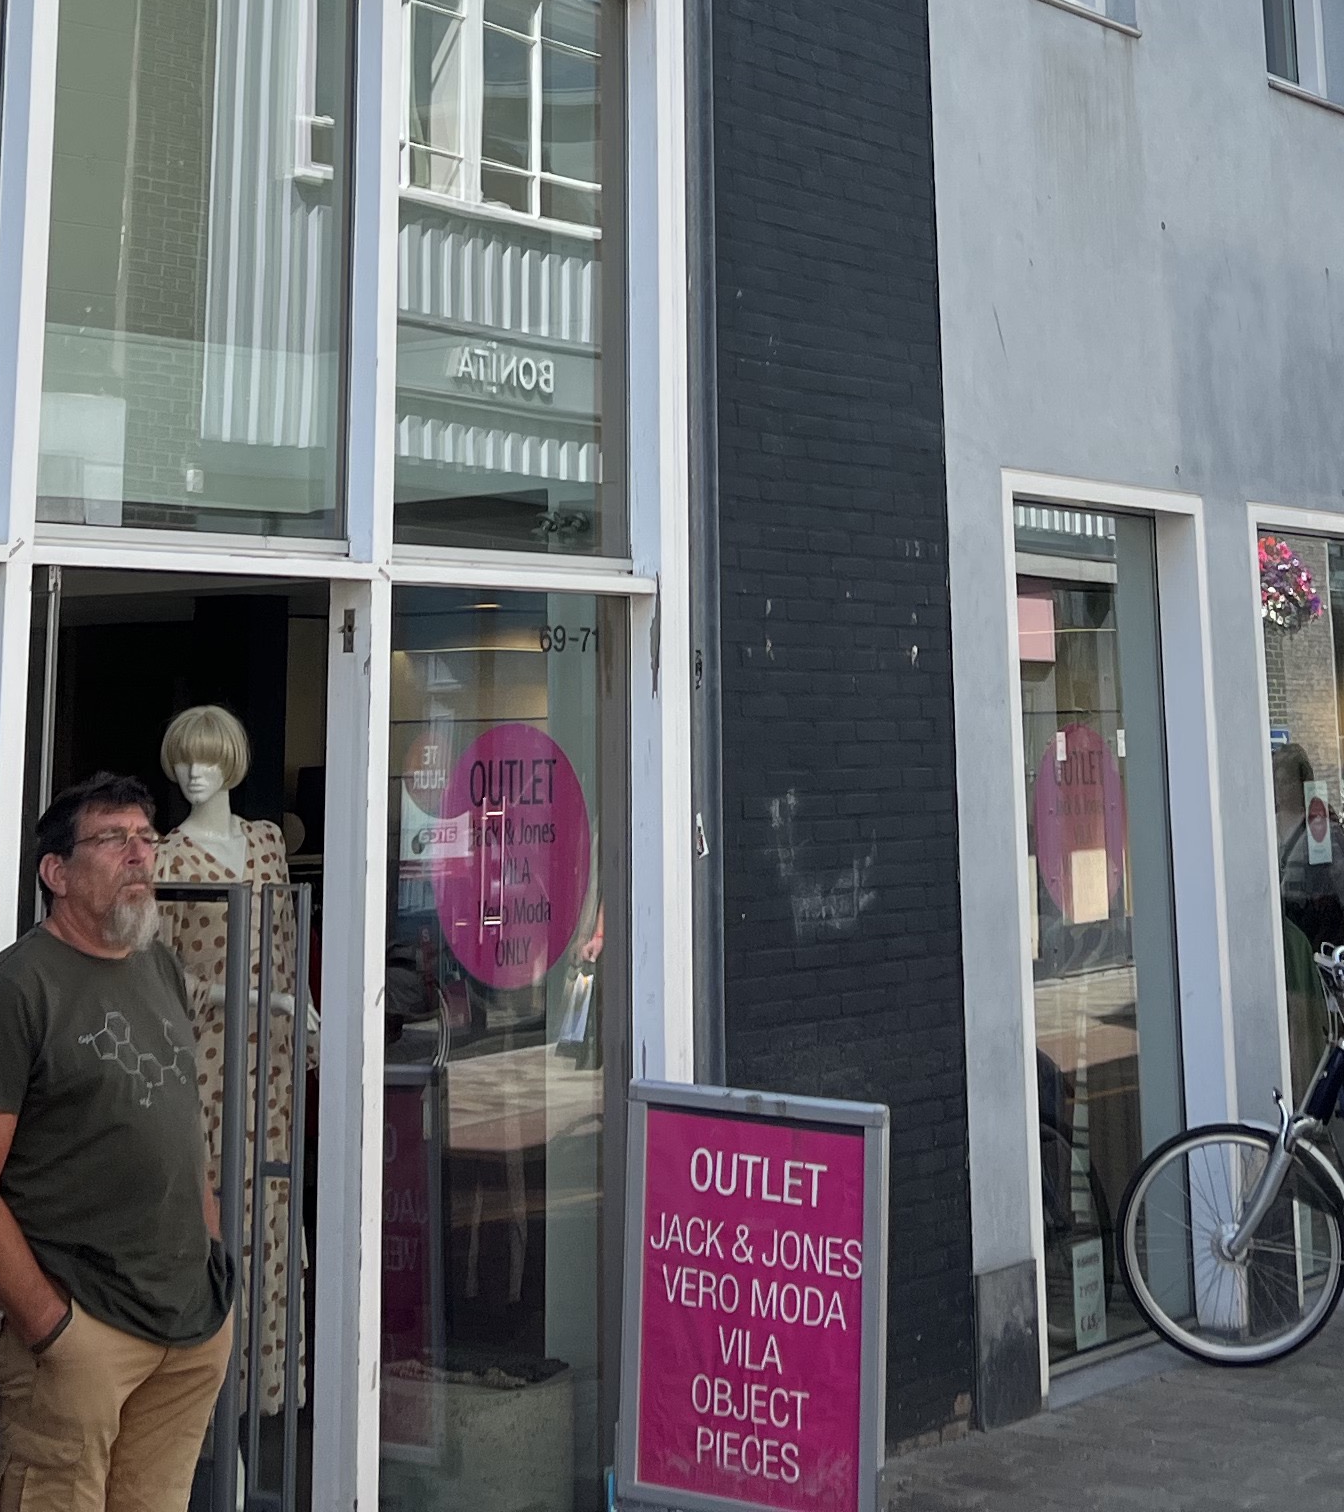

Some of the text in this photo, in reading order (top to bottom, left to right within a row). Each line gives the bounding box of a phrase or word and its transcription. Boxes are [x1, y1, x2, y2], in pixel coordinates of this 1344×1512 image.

[539, 625, 599, 653] 69-71
[469, 758, 557, 807] OUTLET
[519, 819, 556, 846] Jones
[513, 897, 551, 925] Moda
[495, 940, 531, 968] ONLY
[690, 1147, 828, 1208] OUTLET
[650, 1212, 863, 1281] JACK & JONES
[662, 1265, 847, 1331] VERO MODA
[718, 1325, 783, 1375] VILA
[691, 1374, 810, 1431] OBJECT
[696, 1426, 800, 1484] PIECES
